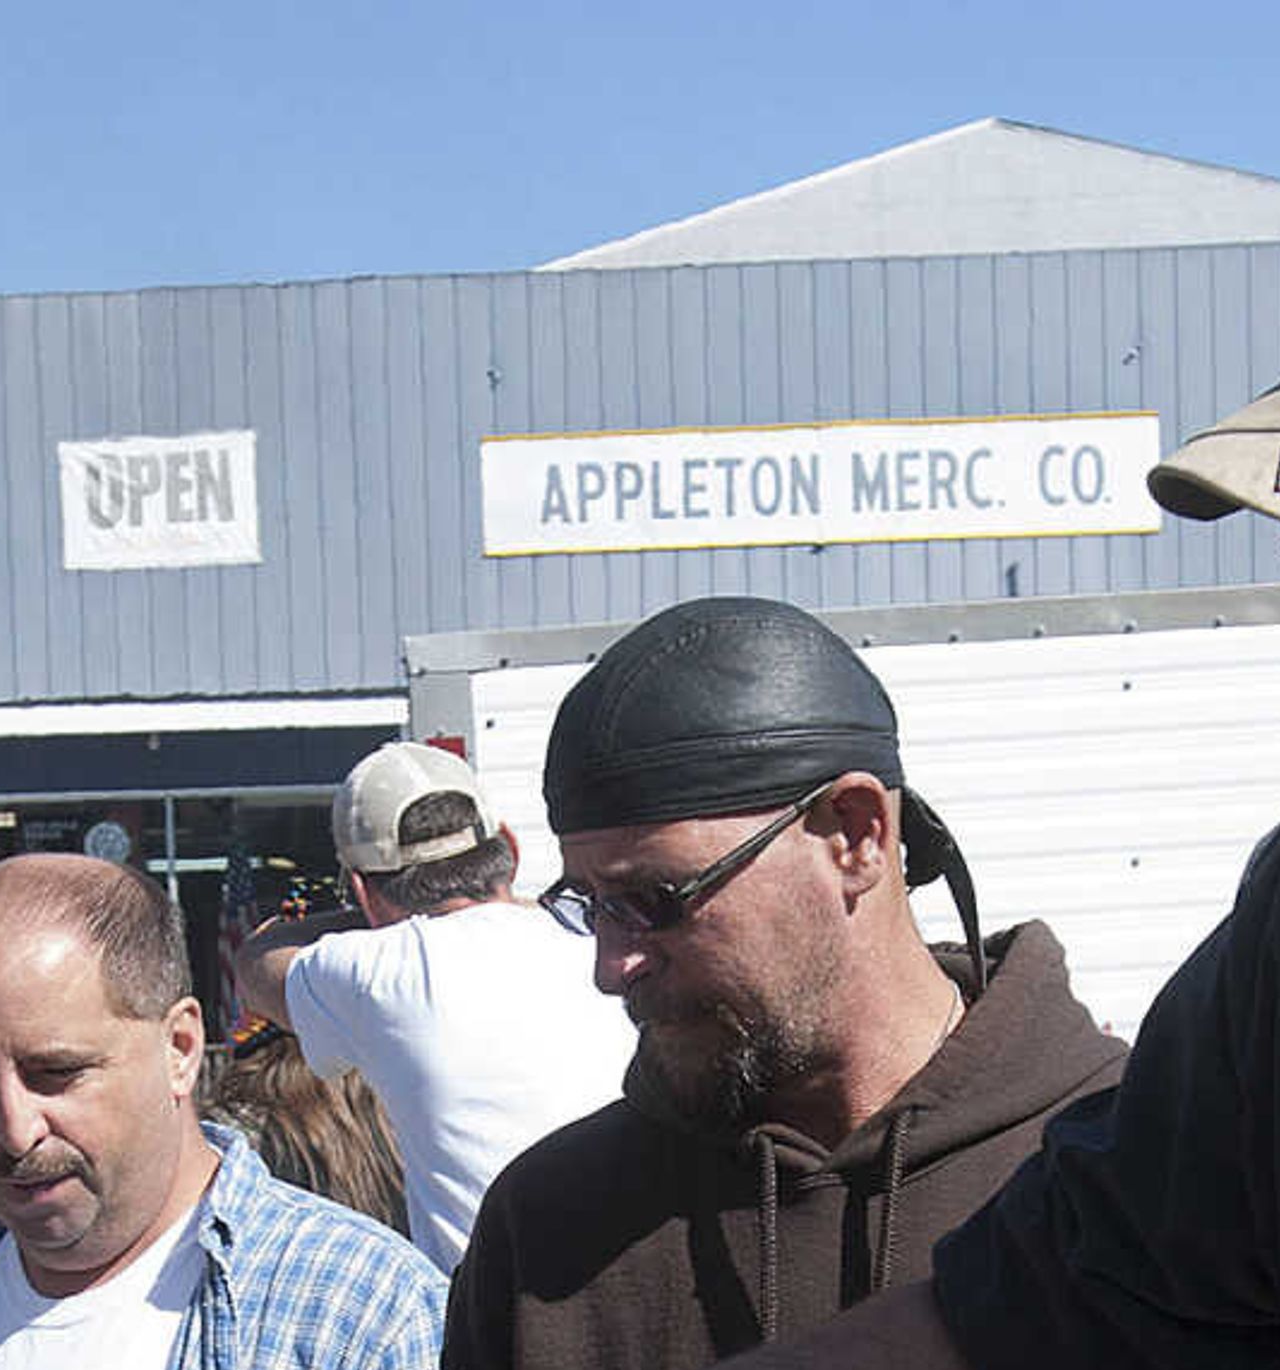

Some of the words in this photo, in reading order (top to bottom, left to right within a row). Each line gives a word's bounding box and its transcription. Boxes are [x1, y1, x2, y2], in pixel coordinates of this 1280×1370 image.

[84, 449, 235, 530] OPEN
[540, 452, 820, 525] APPLETON
[851, 448, 1006, 513] MERC.
[1037, 445, 1113, 506] CO.
